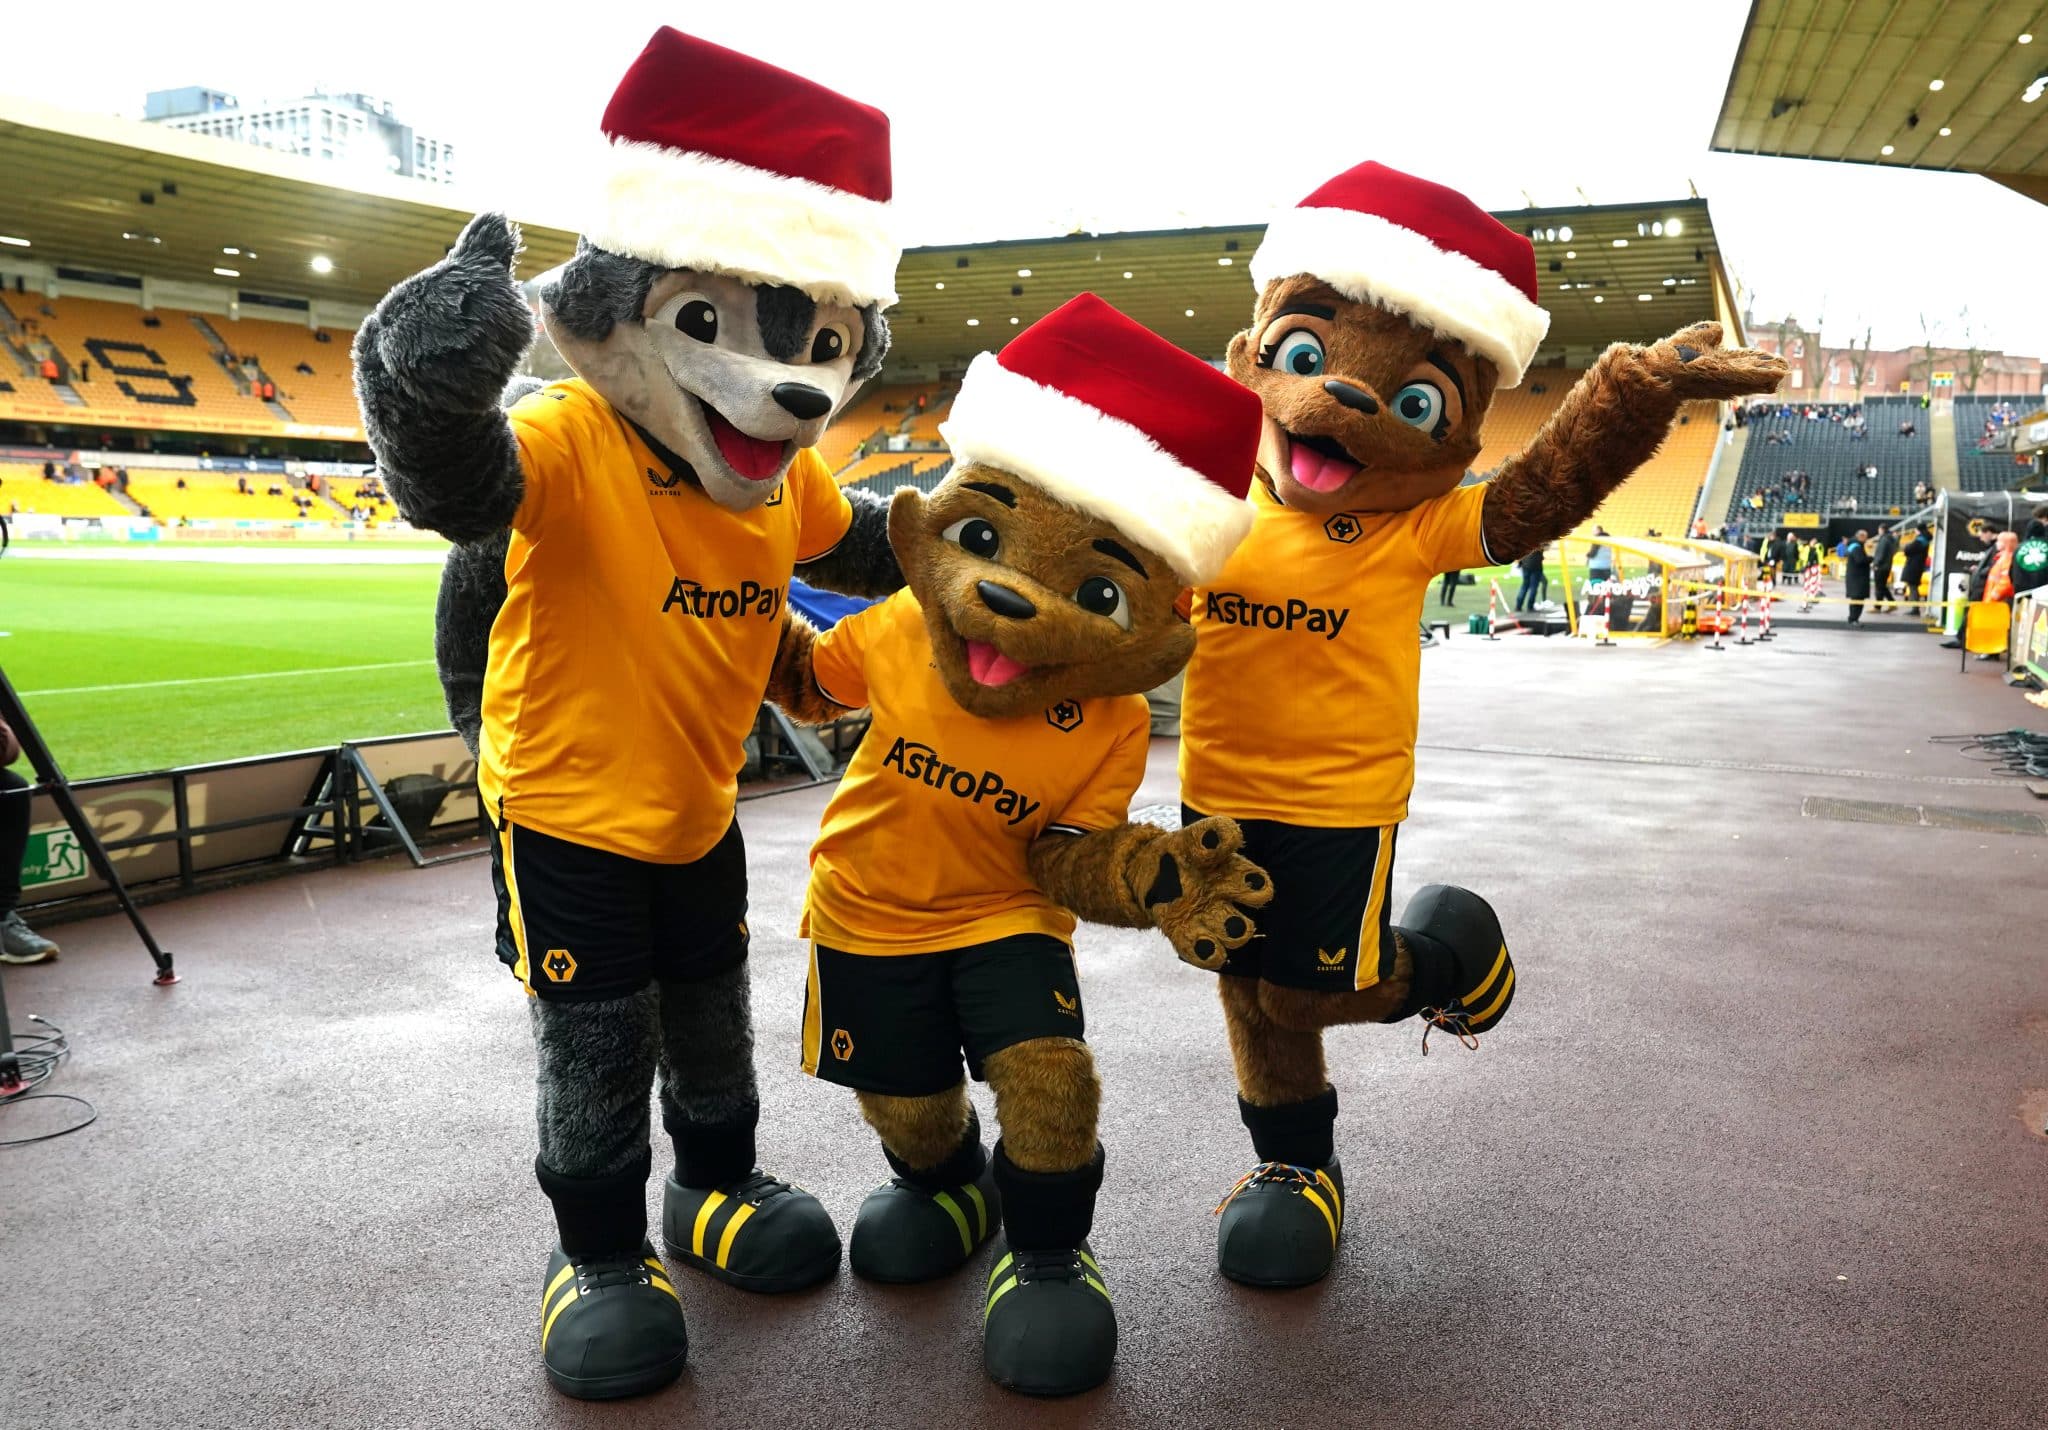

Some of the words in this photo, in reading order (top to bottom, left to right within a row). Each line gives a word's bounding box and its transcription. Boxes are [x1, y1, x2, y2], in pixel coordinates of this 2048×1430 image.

[84, 338, 198, 406] S
[1206, 592, 1350, 640] AstroPay
[882, 737, 1041, 825] AstroPay
